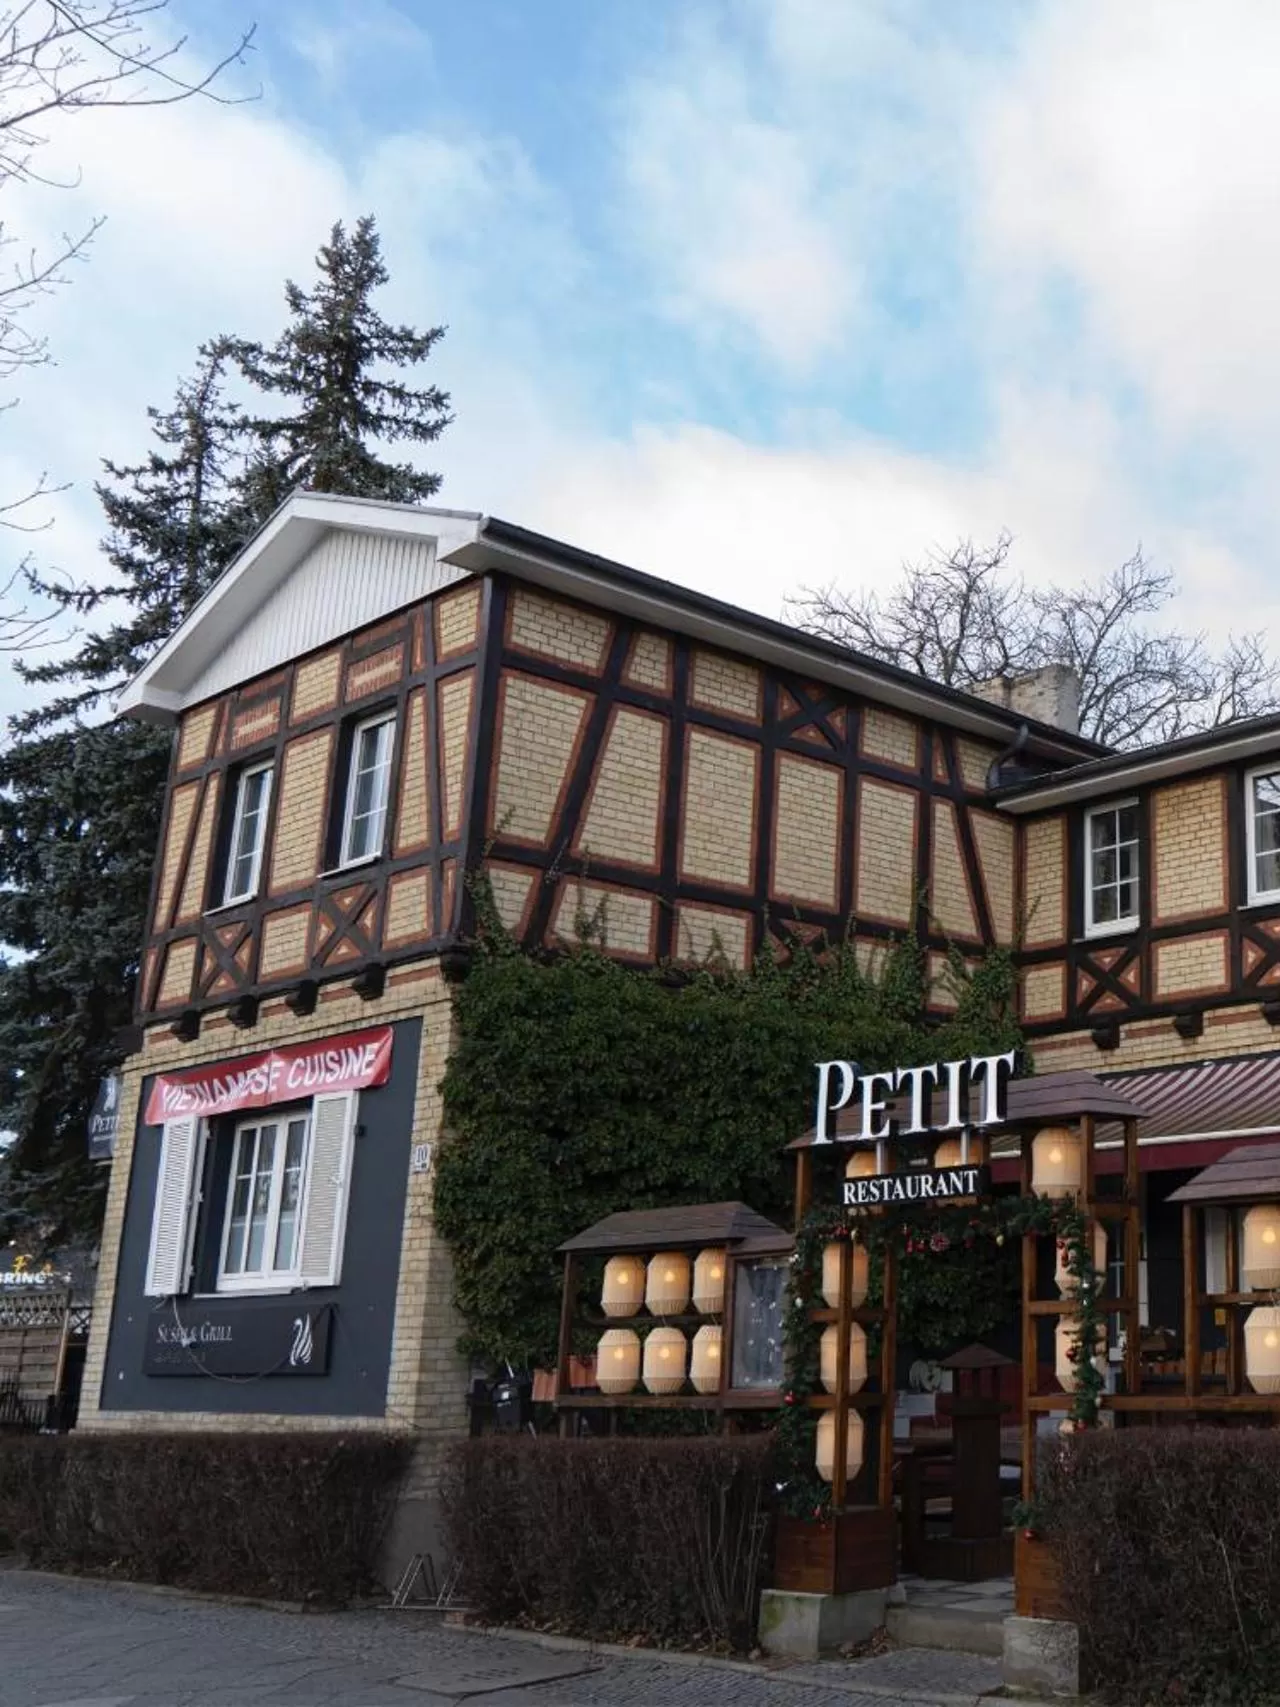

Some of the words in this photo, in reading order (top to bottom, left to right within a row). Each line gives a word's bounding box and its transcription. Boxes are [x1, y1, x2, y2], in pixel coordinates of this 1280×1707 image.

[161, 1061, 285, 1113] VIETNAMESE
[287, 1042, 382, 1089] CUISINE
[811, 1049, 1016, 1145] PETIT
[843, 1170, 979, 1205] RESTAURANT
